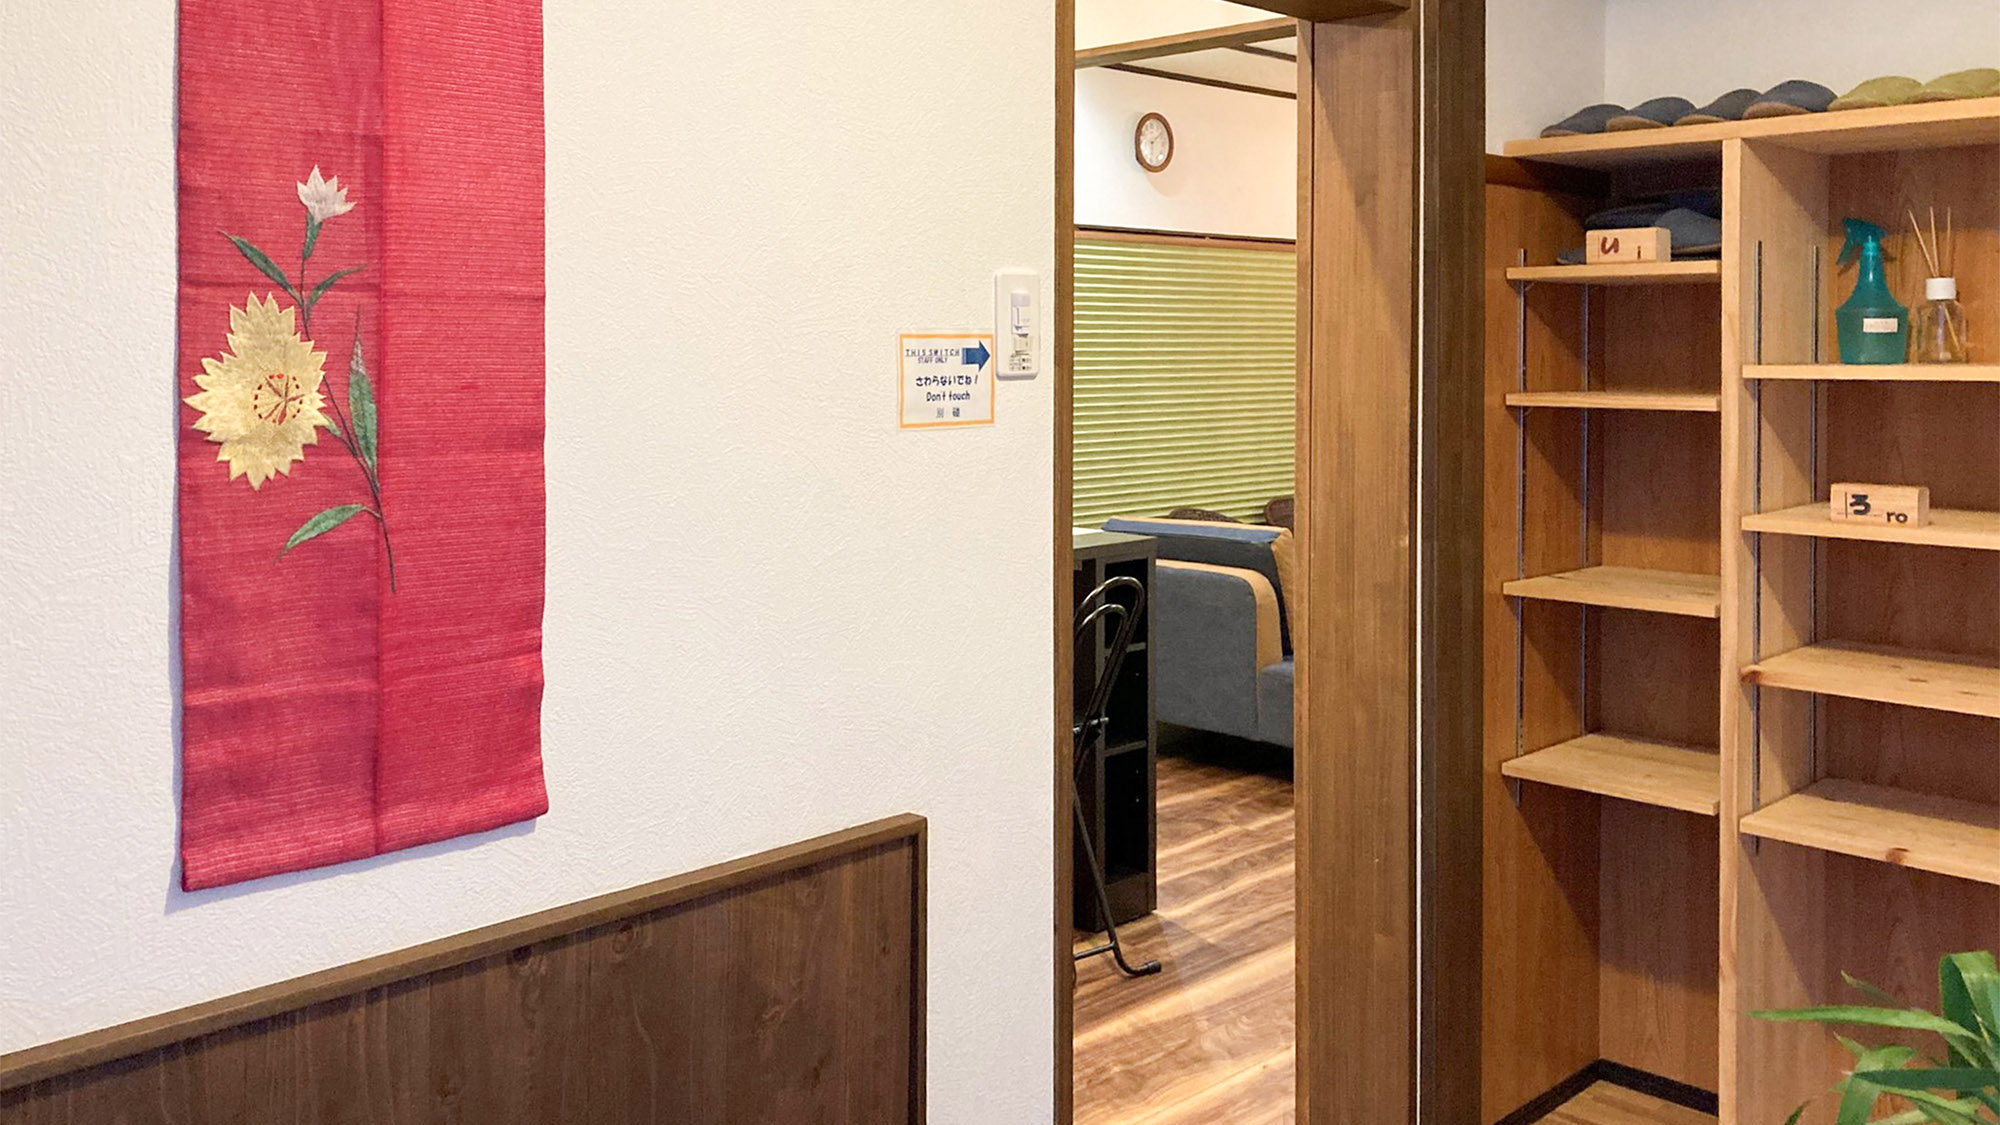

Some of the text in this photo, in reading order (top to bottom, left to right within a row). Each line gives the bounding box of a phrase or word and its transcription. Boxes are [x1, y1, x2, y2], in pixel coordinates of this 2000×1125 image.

[905, 348, 960, 357] THIS SWITCH
[926, 390, 971, 402] Don't touch
[1886, 511, 1908, 523] ro
